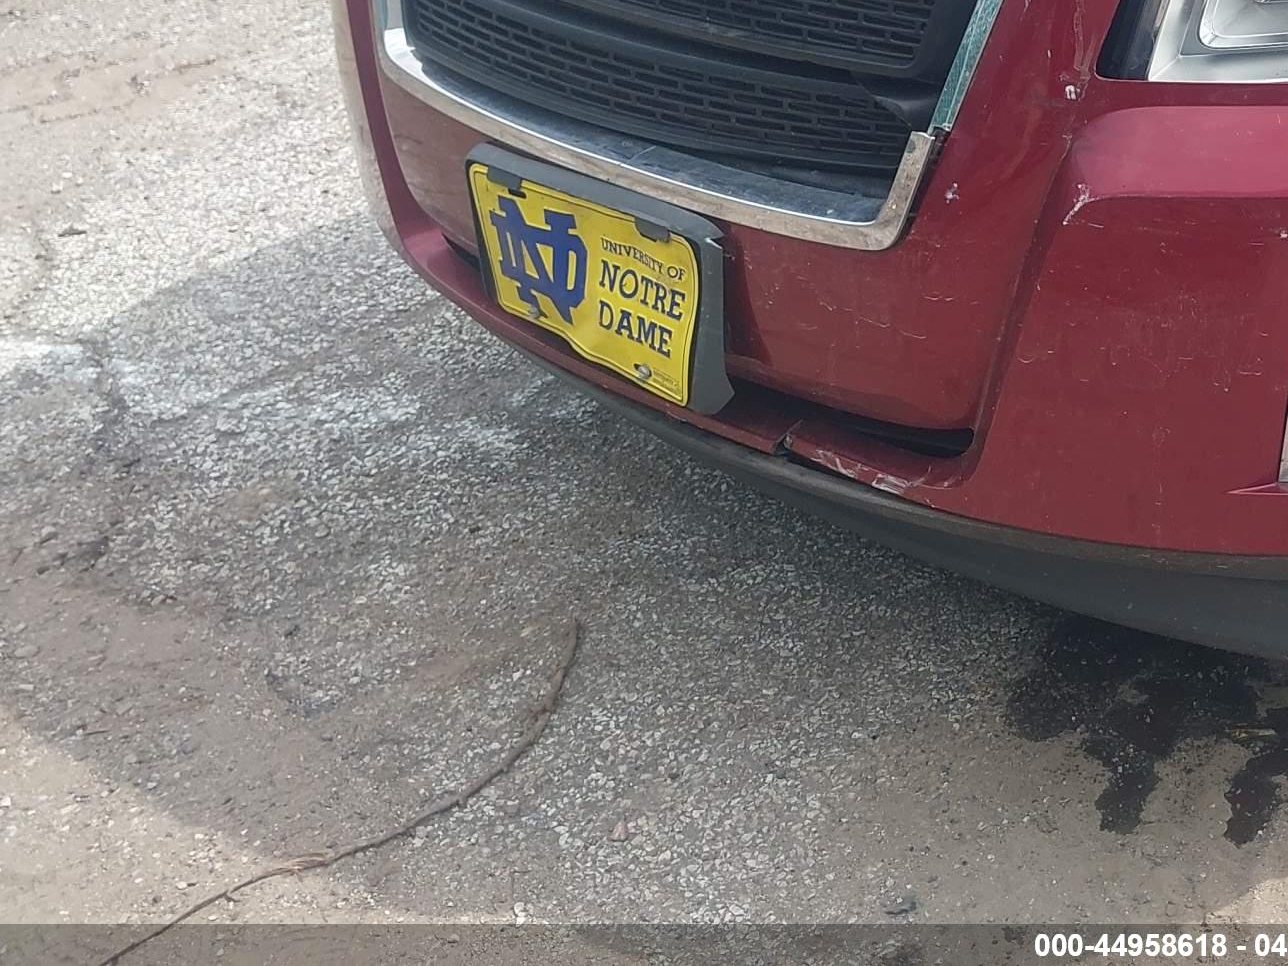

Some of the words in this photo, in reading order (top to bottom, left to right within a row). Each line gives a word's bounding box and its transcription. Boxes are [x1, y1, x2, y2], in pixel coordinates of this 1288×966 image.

[601, 238, 664, 274] UNIVERSITY
[667, 265, 686, 280] OF
[599, 260, 687, 321] NOTRE
[599, 299, 673, 358] DAME
